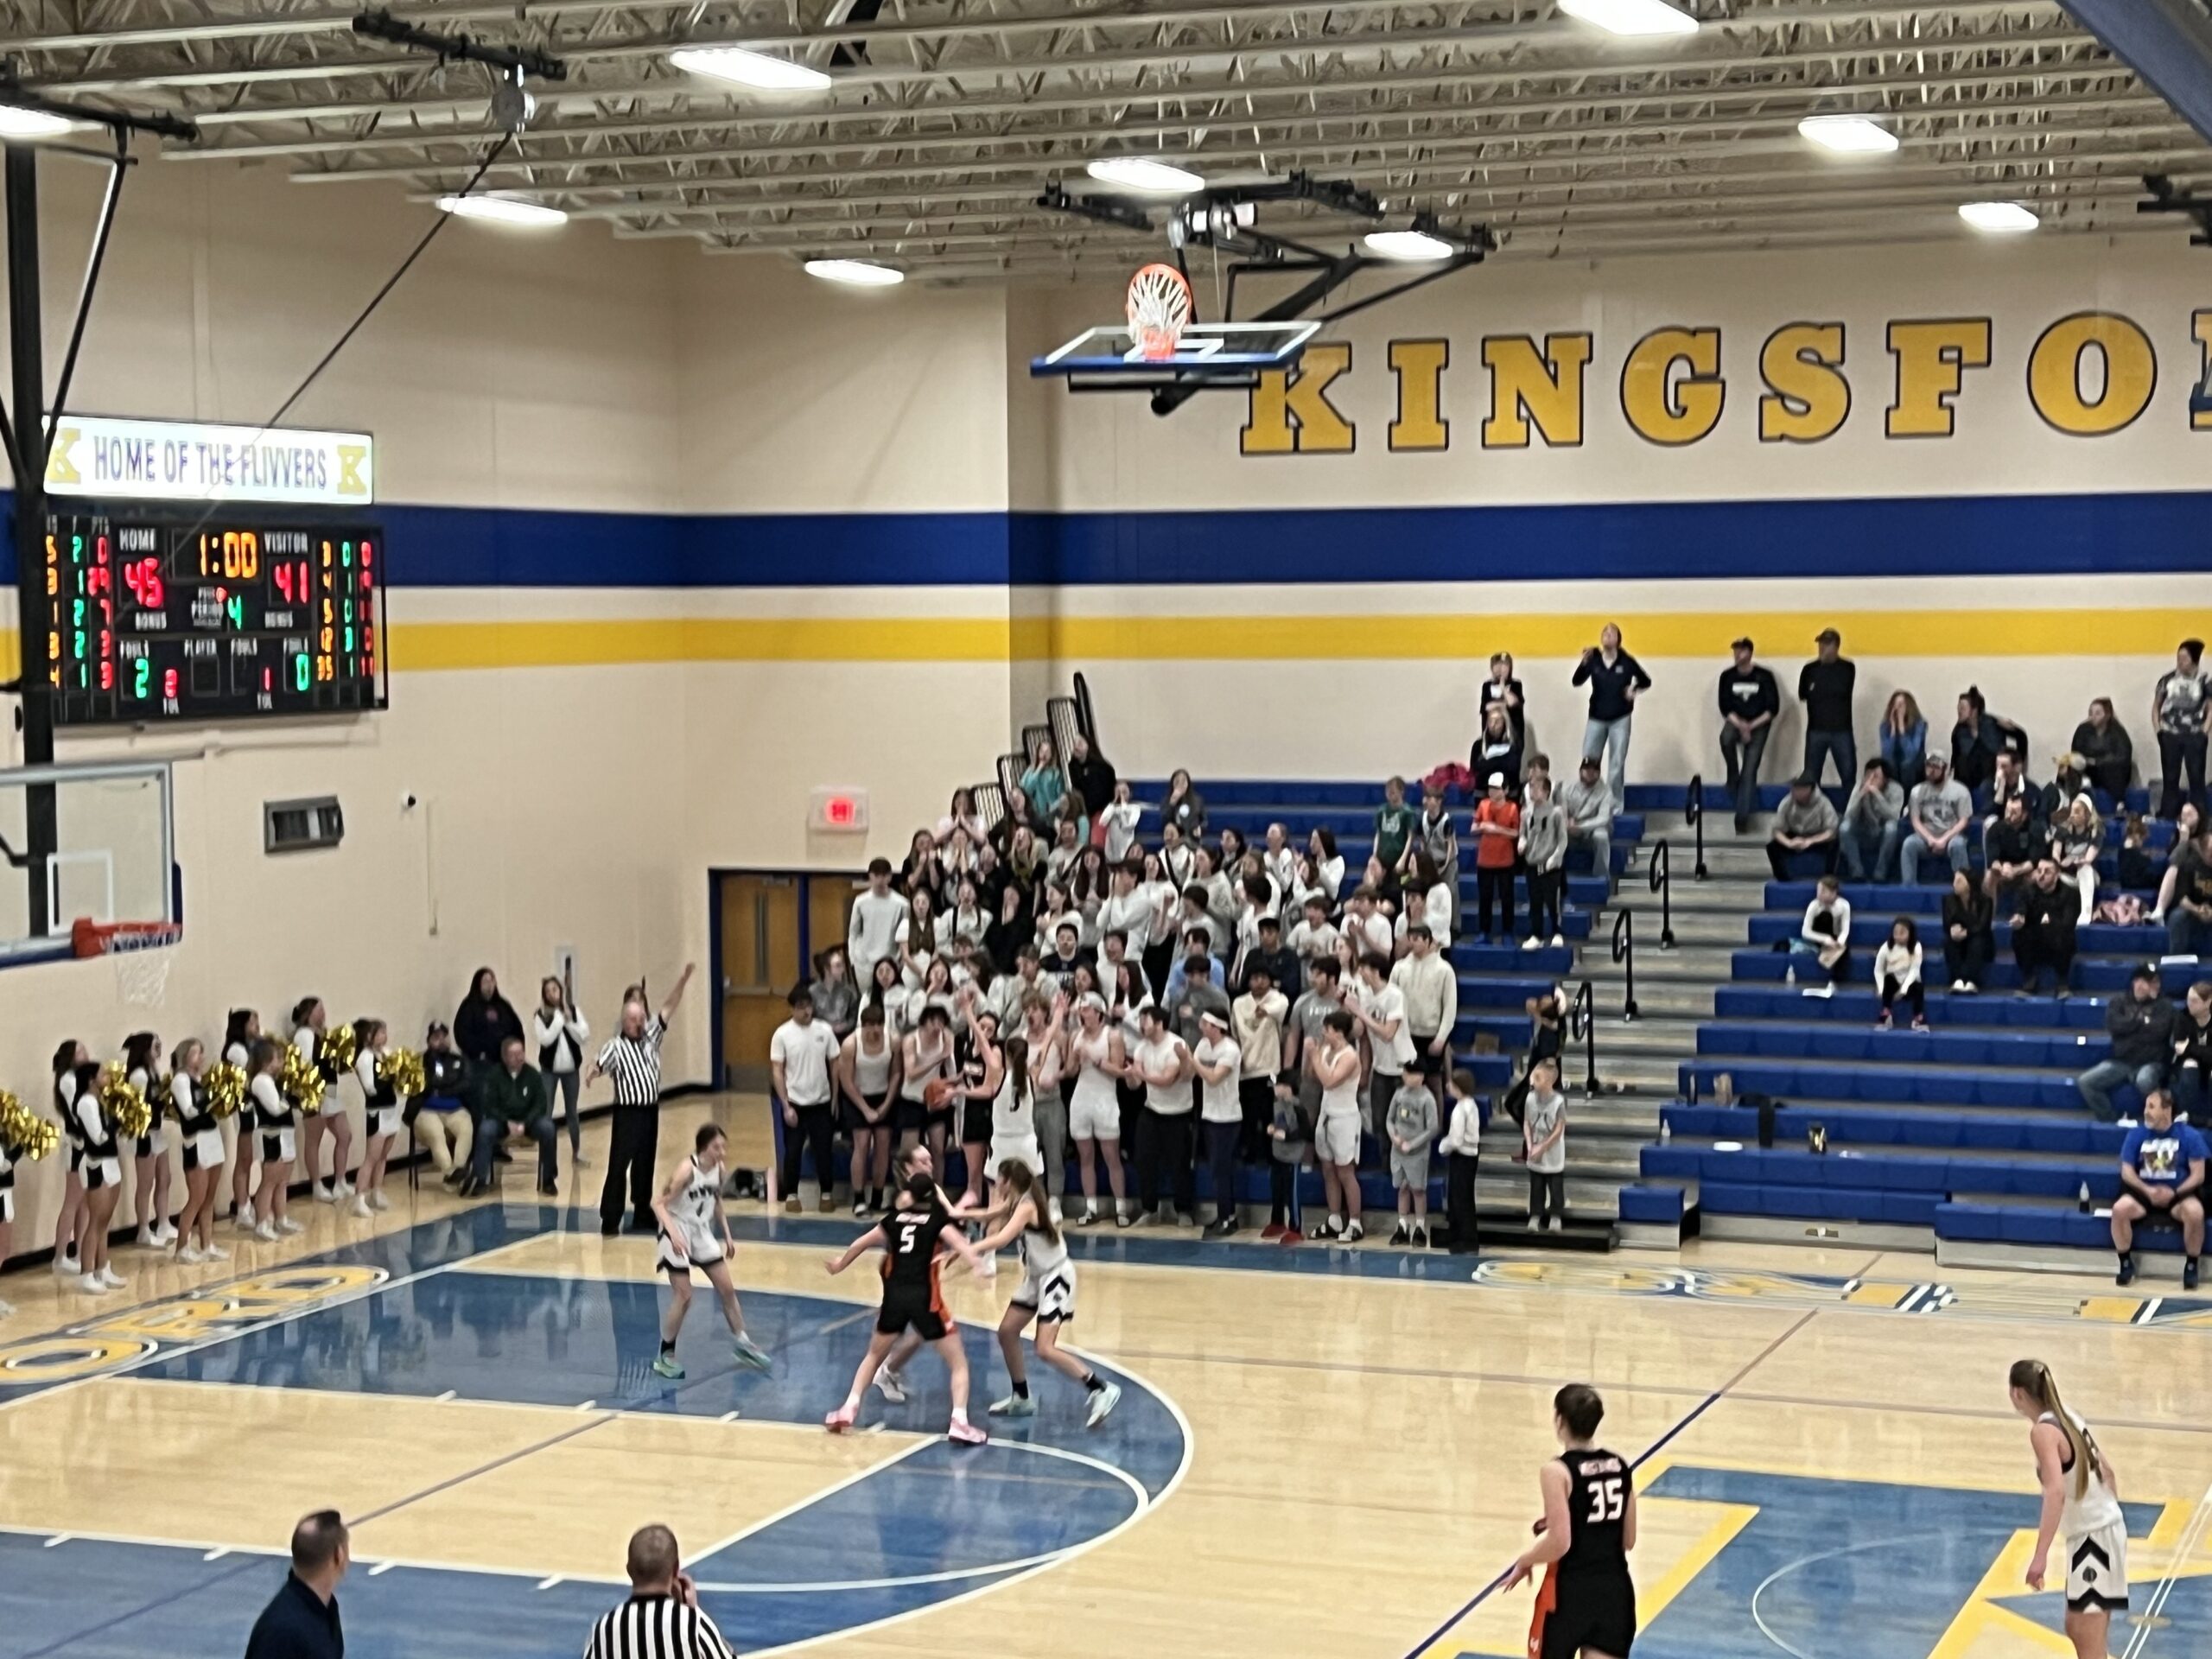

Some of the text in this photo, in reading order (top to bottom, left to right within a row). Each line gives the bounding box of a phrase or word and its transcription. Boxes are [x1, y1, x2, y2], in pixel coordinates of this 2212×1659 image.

[1240, 309, 2212, 455] KINGSFO
[94, 435, 327, 490] HOME OF THE FLIVVERS
[337, 444, 367, 496] K
[200, 531, 257, 579] 1:00
[274, 561, 308, 604] 41
[227, 594, 242, 631] 4
[135, 658, 149, 699] 2
[296, 654, 309, 691] 0
[899, 1225, 917, 1253] 5
[1587, 1478, 1624, 1523] 35
